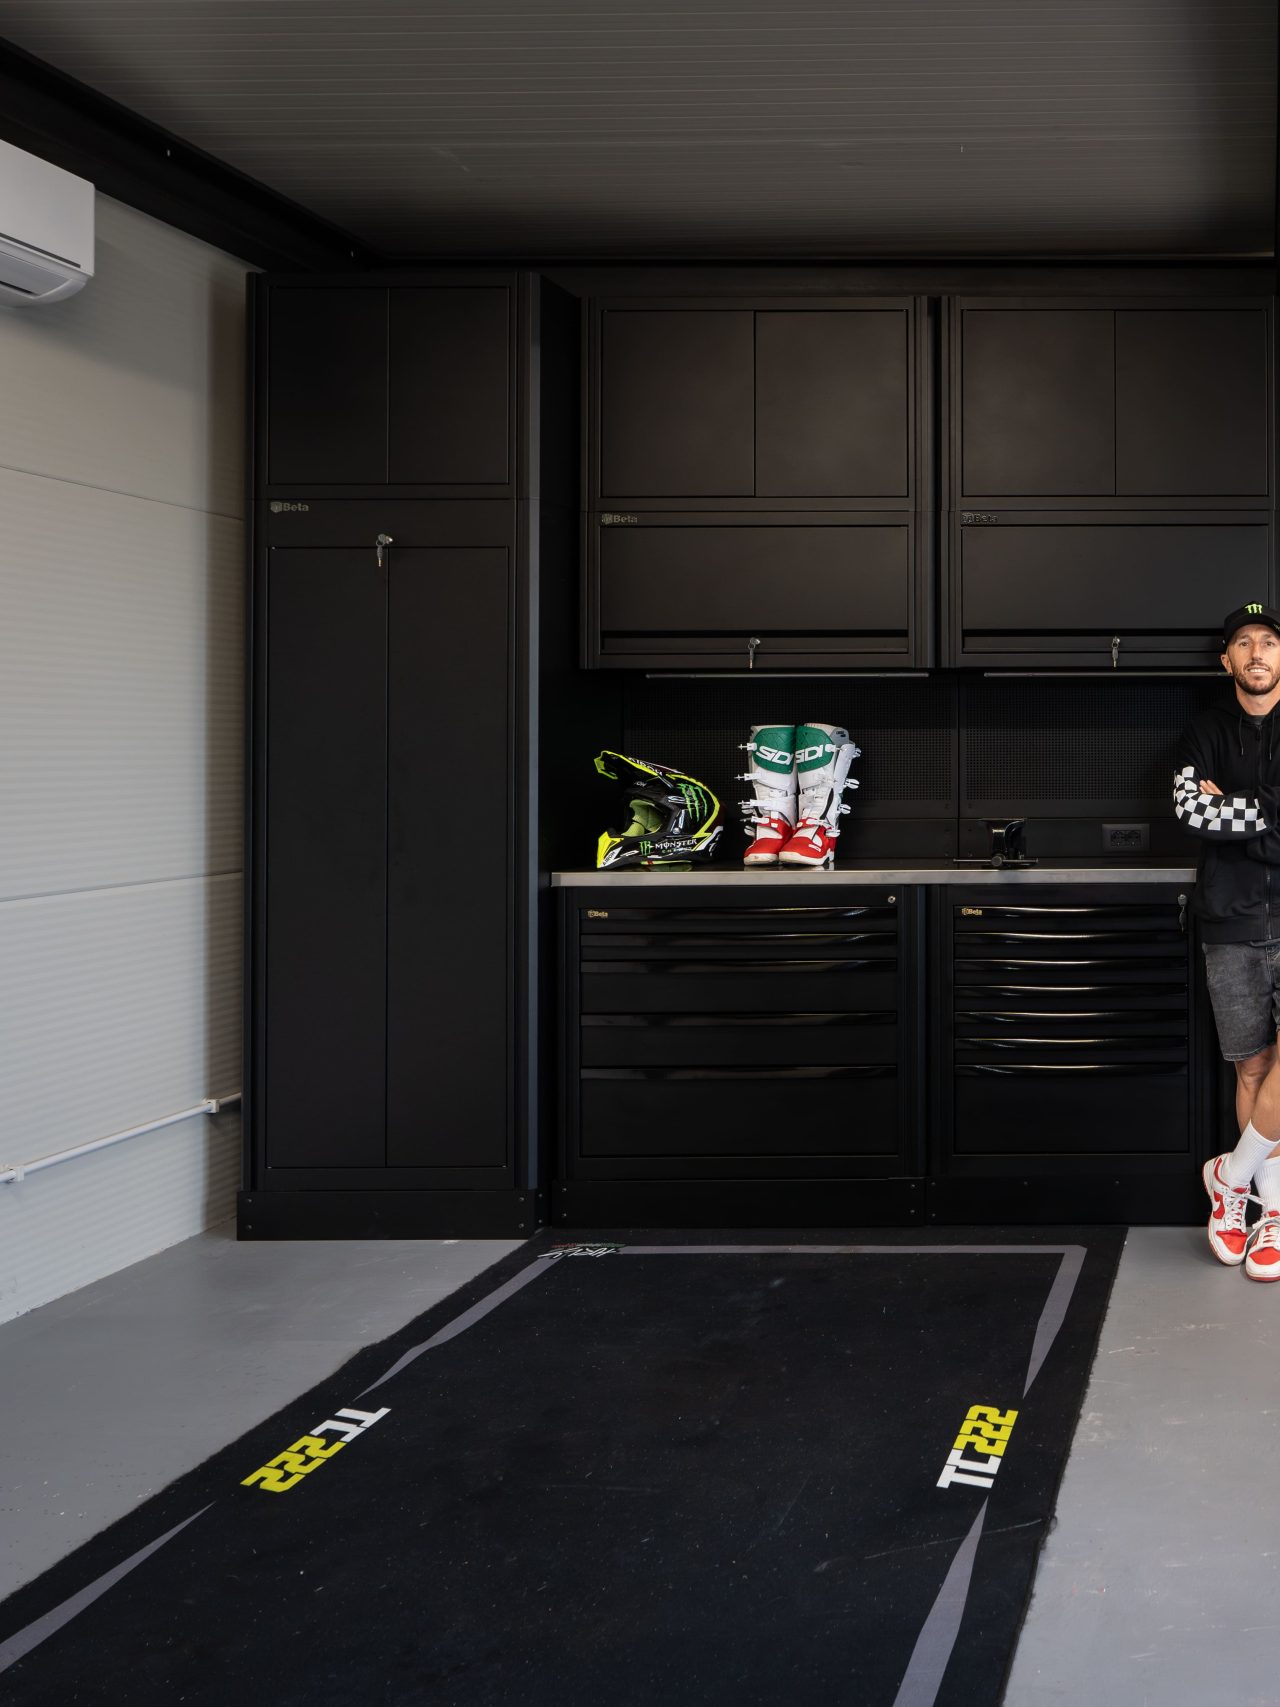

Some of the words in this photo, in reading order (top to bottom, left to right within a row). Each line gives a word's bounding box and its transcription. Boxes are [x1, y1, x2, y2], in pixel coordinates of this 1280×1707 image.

[283, 502, 309, 512] Beta
[613, 513, 638, 523] Beta
[974, 513, 998, 523] Beta
[240, 1407, 392, 1493] TC222
[936, 1404, 1019, 1489] TC222
